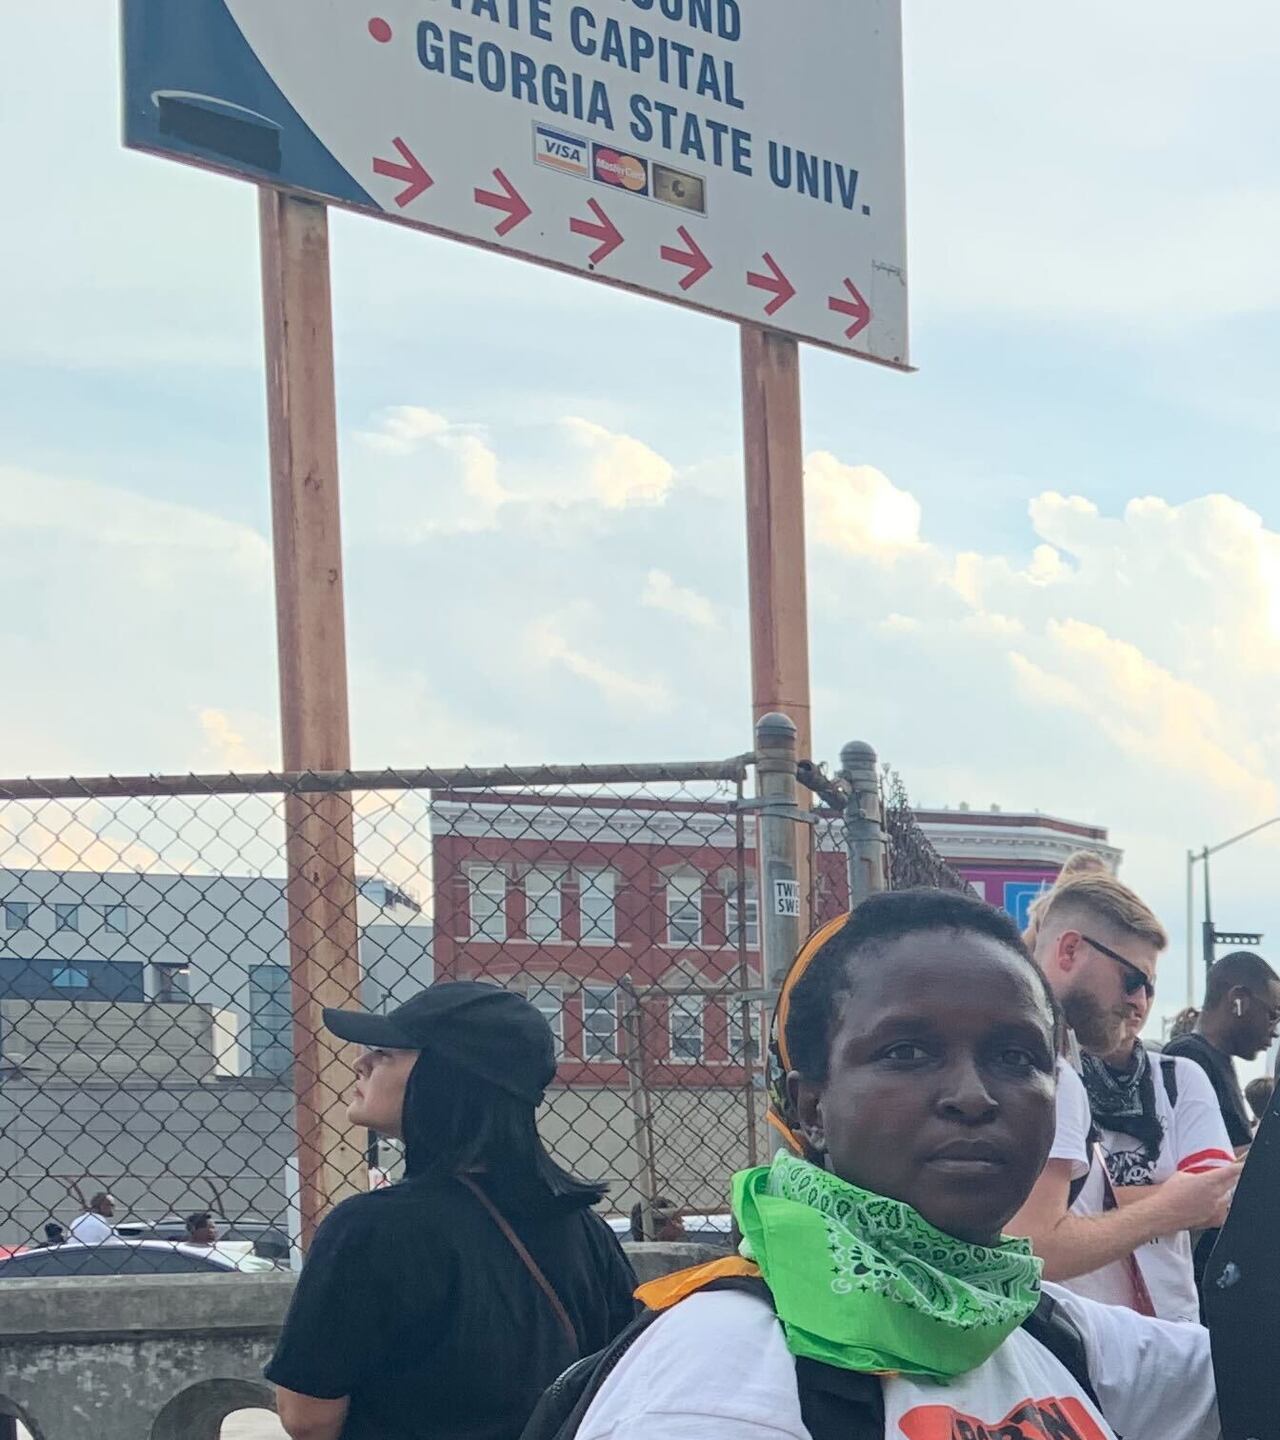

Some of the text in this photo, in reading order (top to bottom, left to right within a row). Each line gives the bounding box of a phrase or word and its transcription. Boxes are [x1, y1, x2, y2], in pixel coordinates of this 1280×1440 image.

[569, 6, 744, 110] CAPITAL
[416, 20, 615, 131] GEORGIA
[629, 94, 752, 177] STATE
[768, 140, 871, 216] UNIV.
[545, 139, 581, 163] VISA
